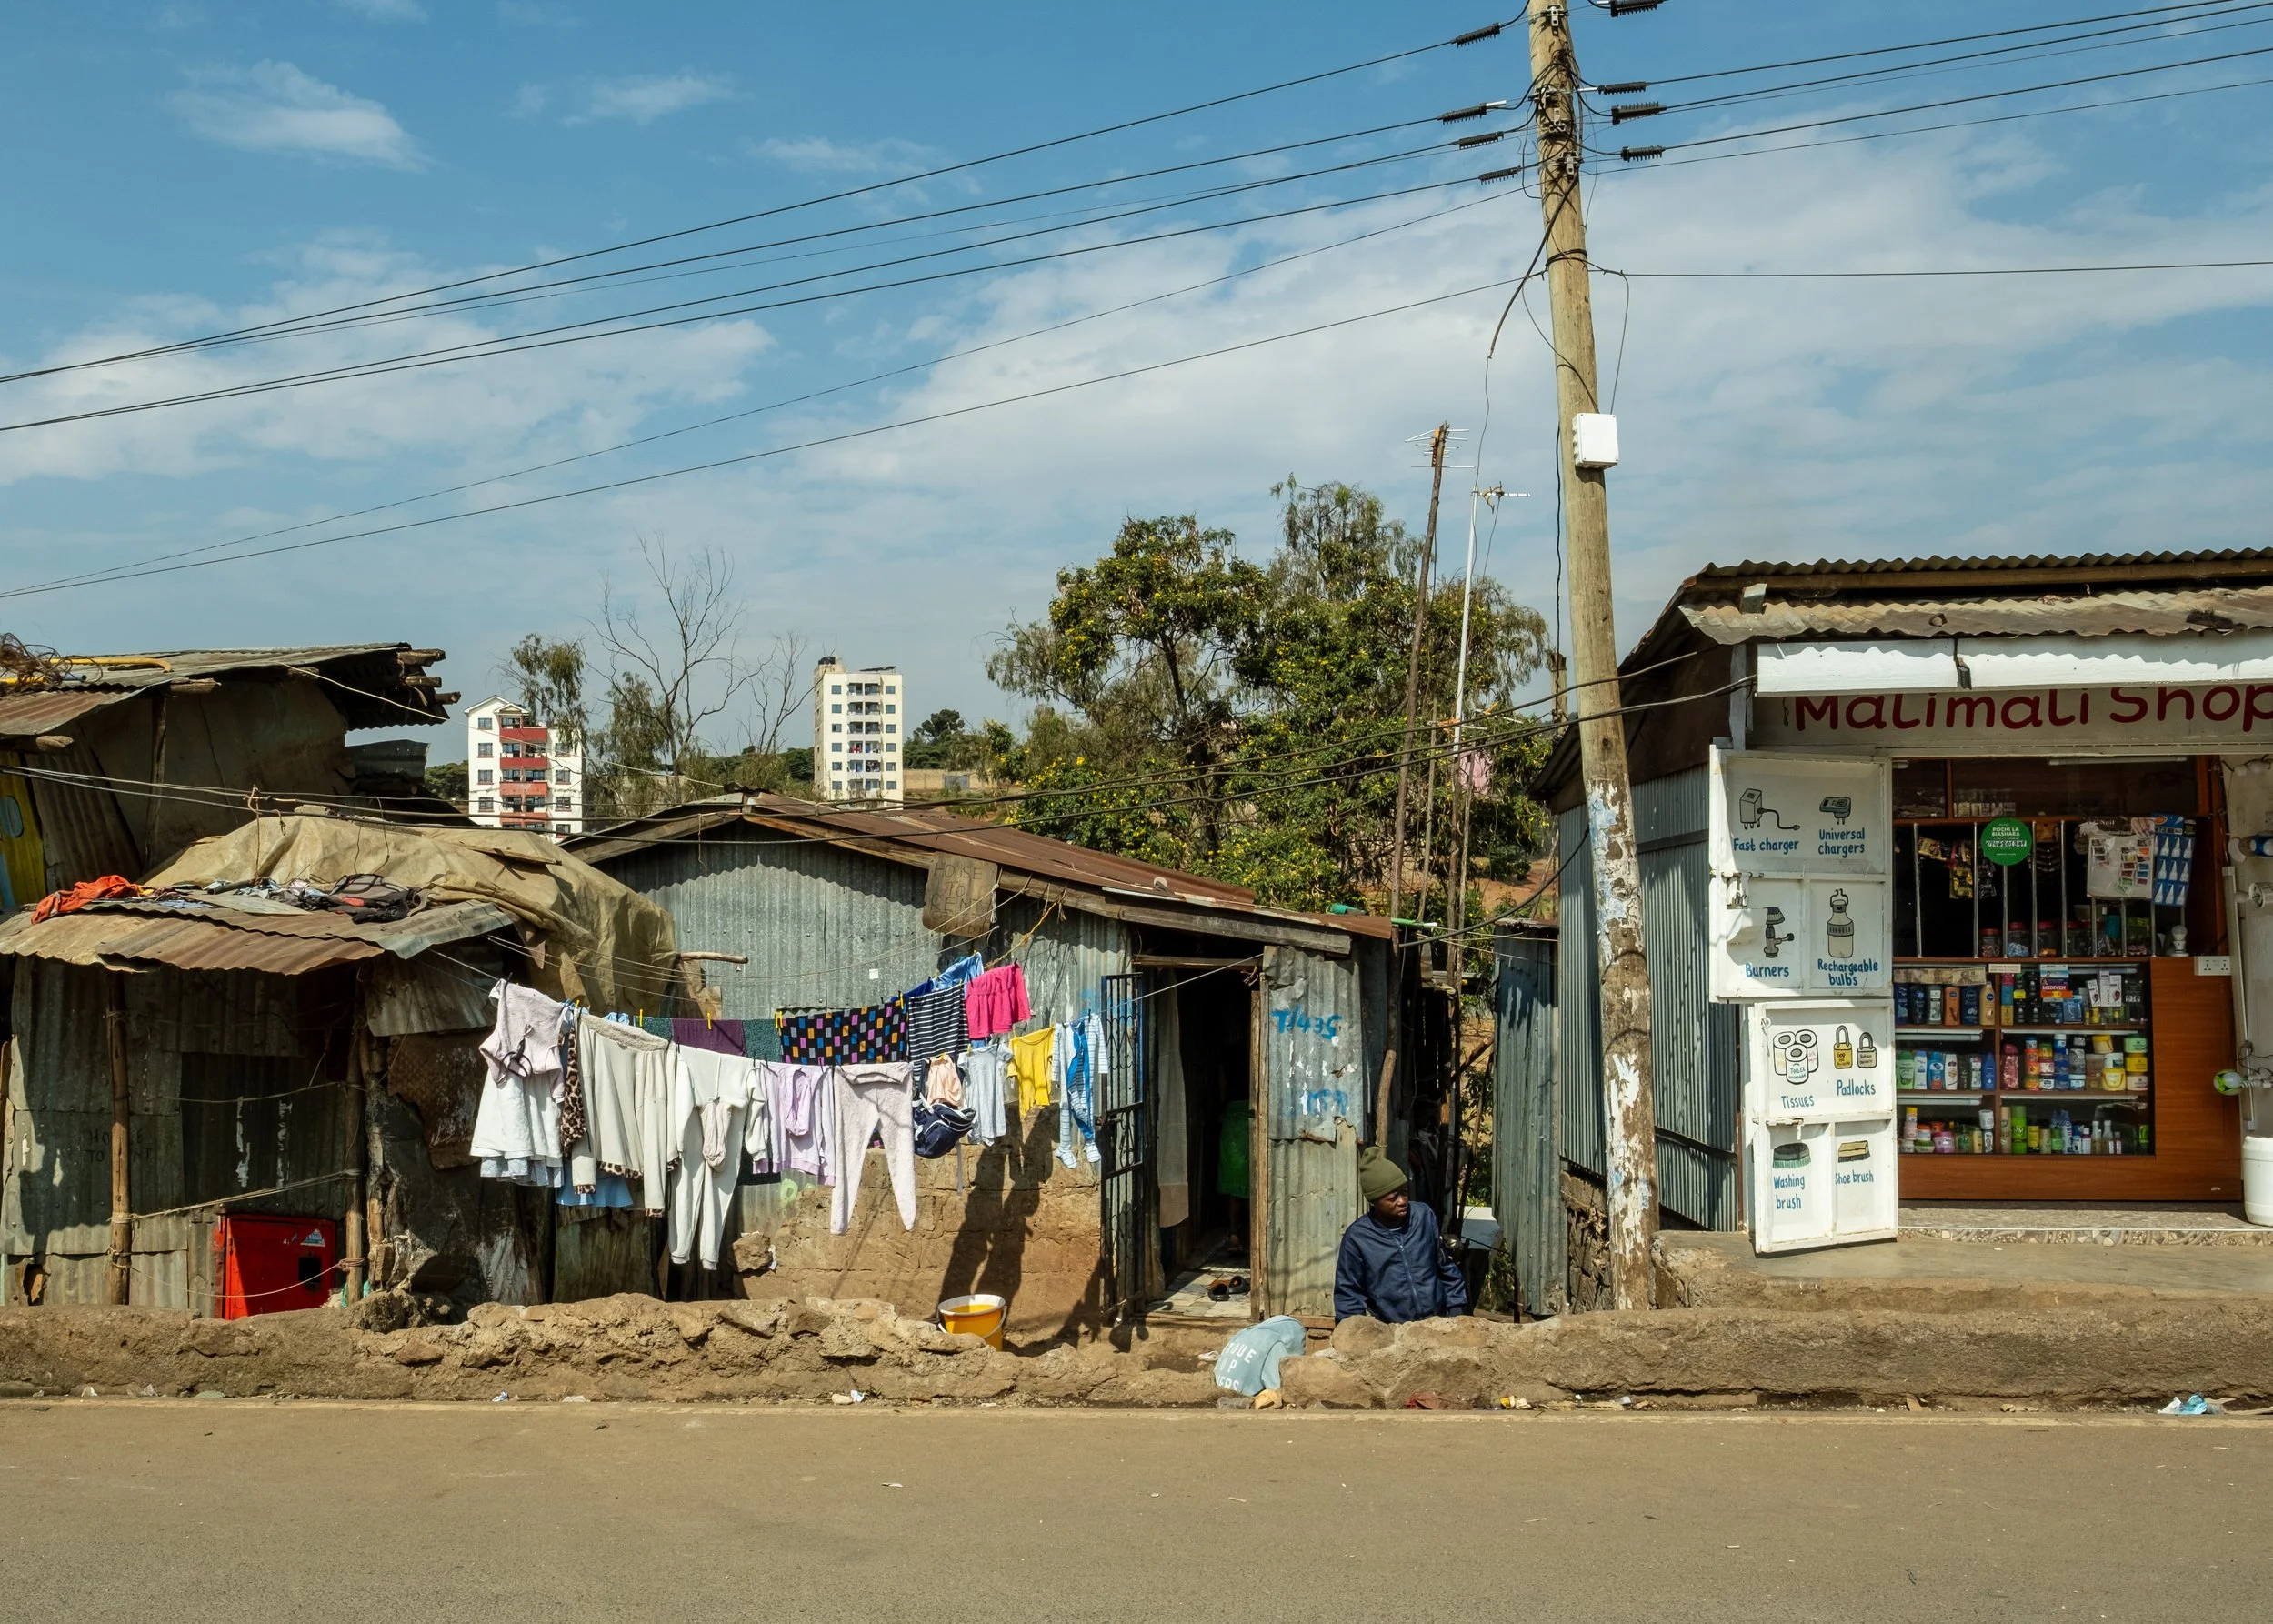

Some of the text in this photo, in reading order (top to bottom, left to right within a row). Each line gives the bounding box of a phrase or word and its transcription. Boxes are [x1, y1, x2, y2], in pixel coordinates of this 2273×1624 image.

[2109, 685, 2273, 733] Shop
[1819, 828, 1865, 840] Universal
[1733, 837, 1799, 855] Fast charger
[1818, 842, 1865, 858] chargers
[935, 863, 983, 879] HOUSE
[945, 882, 966, 897] TO
[1746, 962, 1789, 977] Burners
[1818, 958, 1878, 976] Rechargeable
[1828, 974, 1857, 986] bulbs
[1837, 1078, 1876, 1096] Padlocks
[1781, 1095, 1815, 1109] Tissues
[90, 1128, 144, 1144] HOE
[1773, 1173, 1805, 1189] Washing
[1835, 1169, 1874, 1185] Shoe brush
[1776, 1193, 1801, 1209] brush
